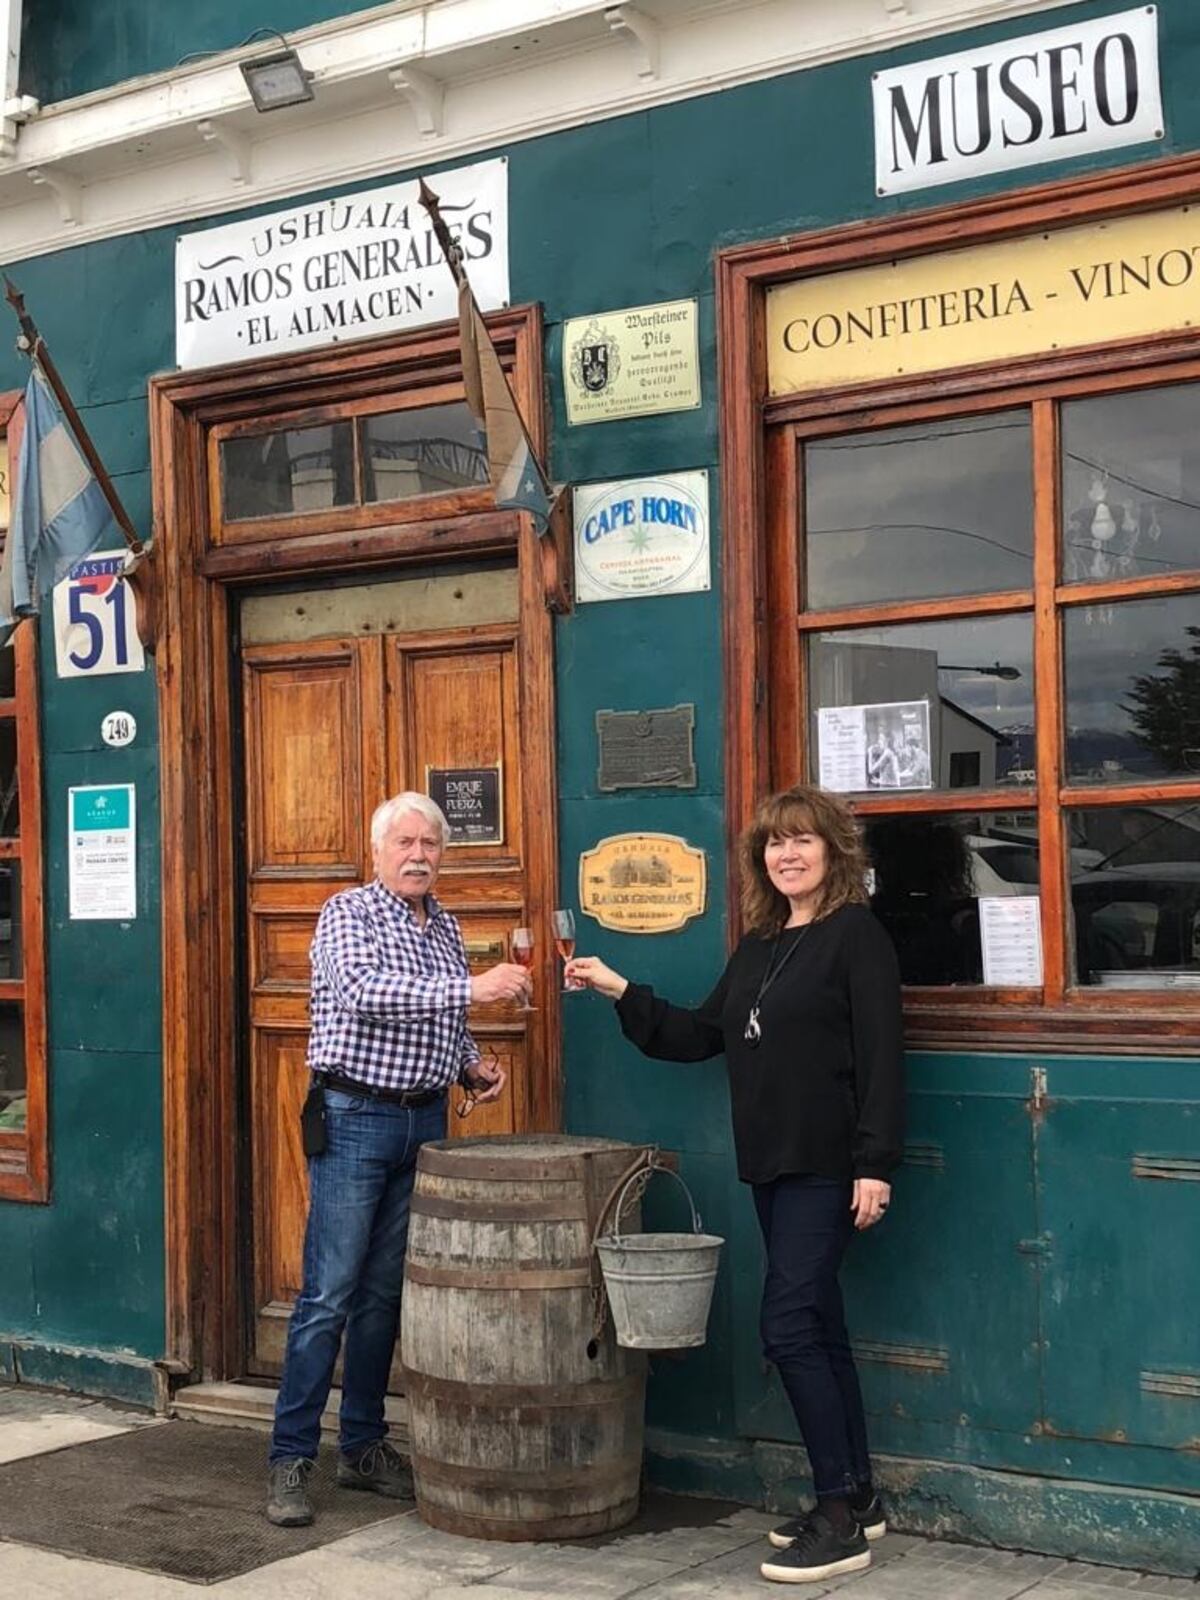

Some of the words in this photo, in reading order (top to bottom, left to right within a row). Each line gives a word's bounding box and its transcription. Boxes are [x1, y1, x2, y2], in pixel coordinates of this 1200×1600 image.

[888, 32, 1139, 173] MUSEO
[251, 202, 411, 257] USHUAIA
[184, 263, 292, 323] RAMOS
[248, 316, 278, 345] EL
[288, 283, 426, 337] ALMACEN
[782, 279, 1033, 354] CONFITERIA
[1068, 246, 1200, 302] VINO
[642, 331, 671, 349] Pils
[585, 499, 635, 544] CAPE
[642, 497, 697, 535] HORN
[69, 583, 127, 669] 51
[108, 718, 129, 740] 749
